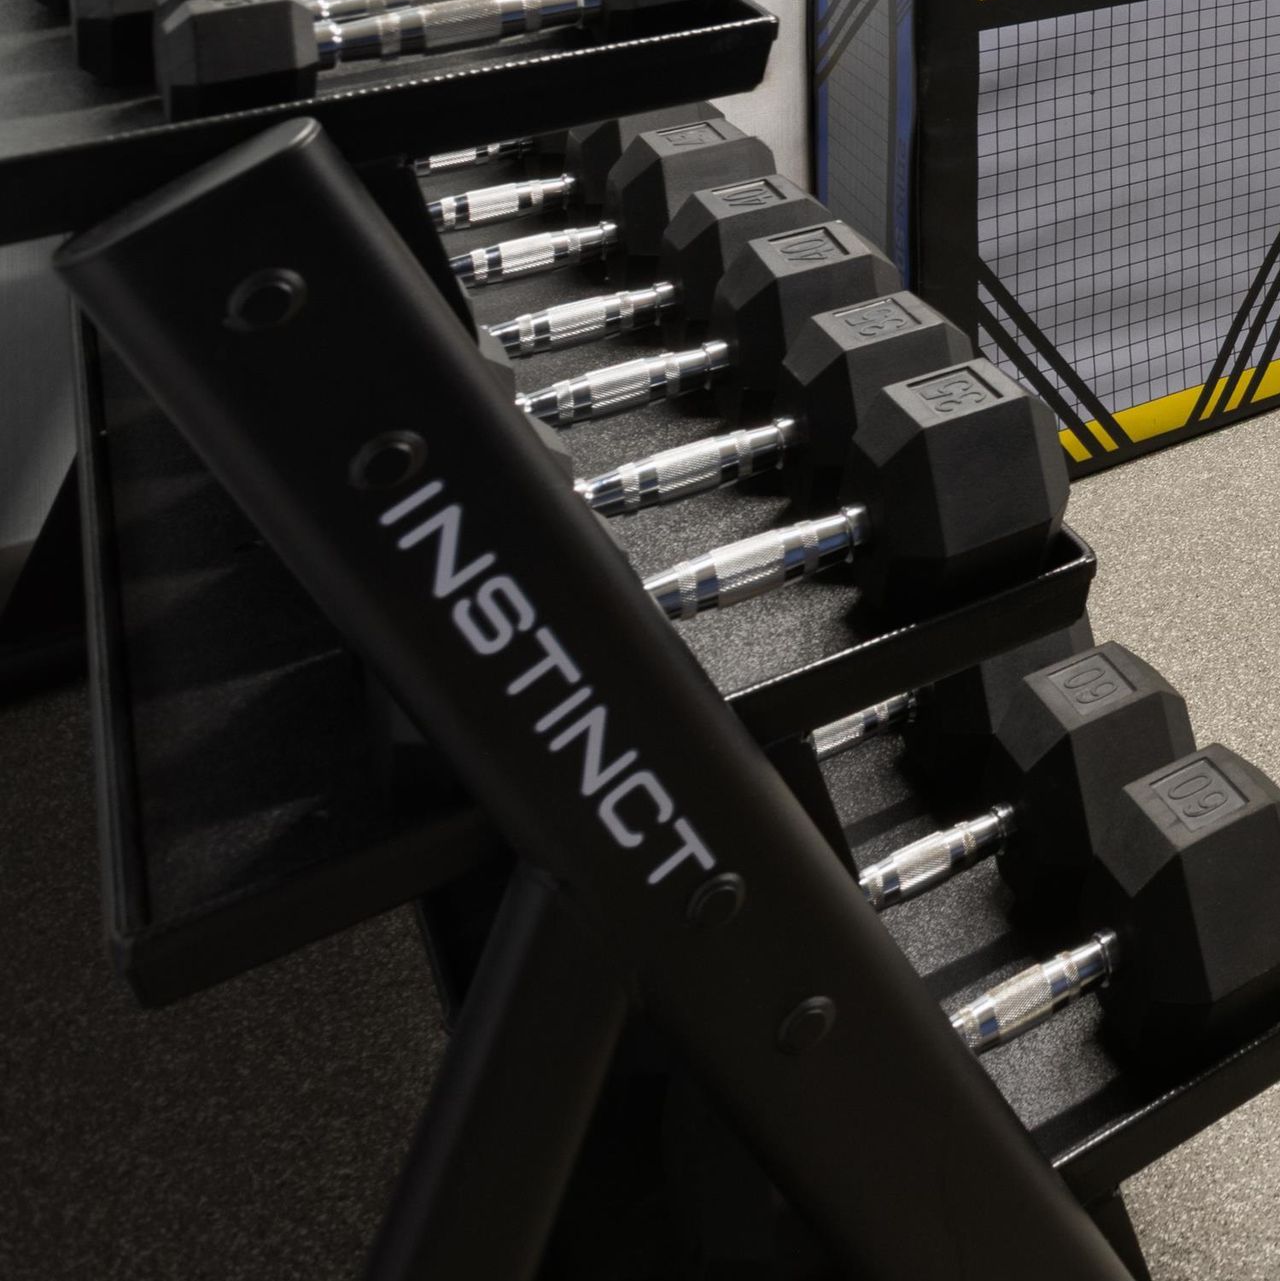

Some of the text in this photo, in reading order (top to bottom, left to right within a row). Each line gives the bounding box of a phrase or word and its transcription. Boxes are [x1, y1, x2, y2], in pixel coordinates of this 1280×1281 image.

[919, 380, 987, 413] 35
[379, 479, 716, 885] INSTINCT
[1167, 775, 1229, 819] 60
